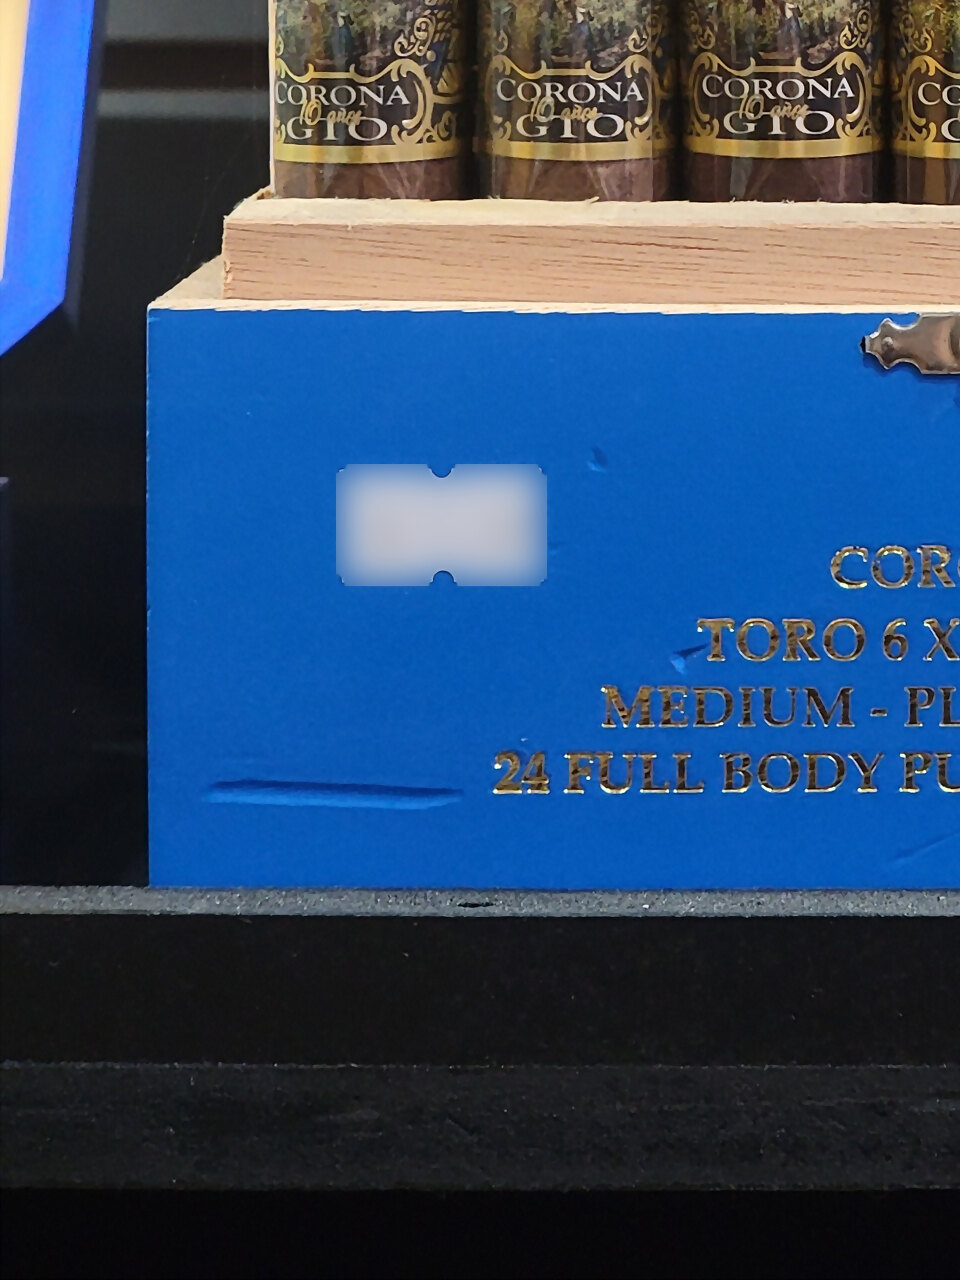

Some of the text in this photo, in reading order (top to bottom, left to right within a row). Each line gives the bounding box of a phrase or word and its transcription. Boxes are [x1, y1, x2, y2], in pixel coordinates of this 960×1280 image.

[275, 81, 411, 106] CORONA
[496, 78, 644, 103] CORONA
[702, 74, 855, 100] CORONA
[287, 117, 388, 141] GTO
[516, 114, 625, 138] GTO
[723, 110, 835, 135] GTO
[697, 617, 867, 662] TORO
[882, 618, 909, 662] 6
[922, 618, 960, 662] X
[601, 684, 856, 729] MEDIUM
[492, 750, 550, 795] 24
[563, 752, 704, 794] FULL
[719, 751, 885, 793] BODY
